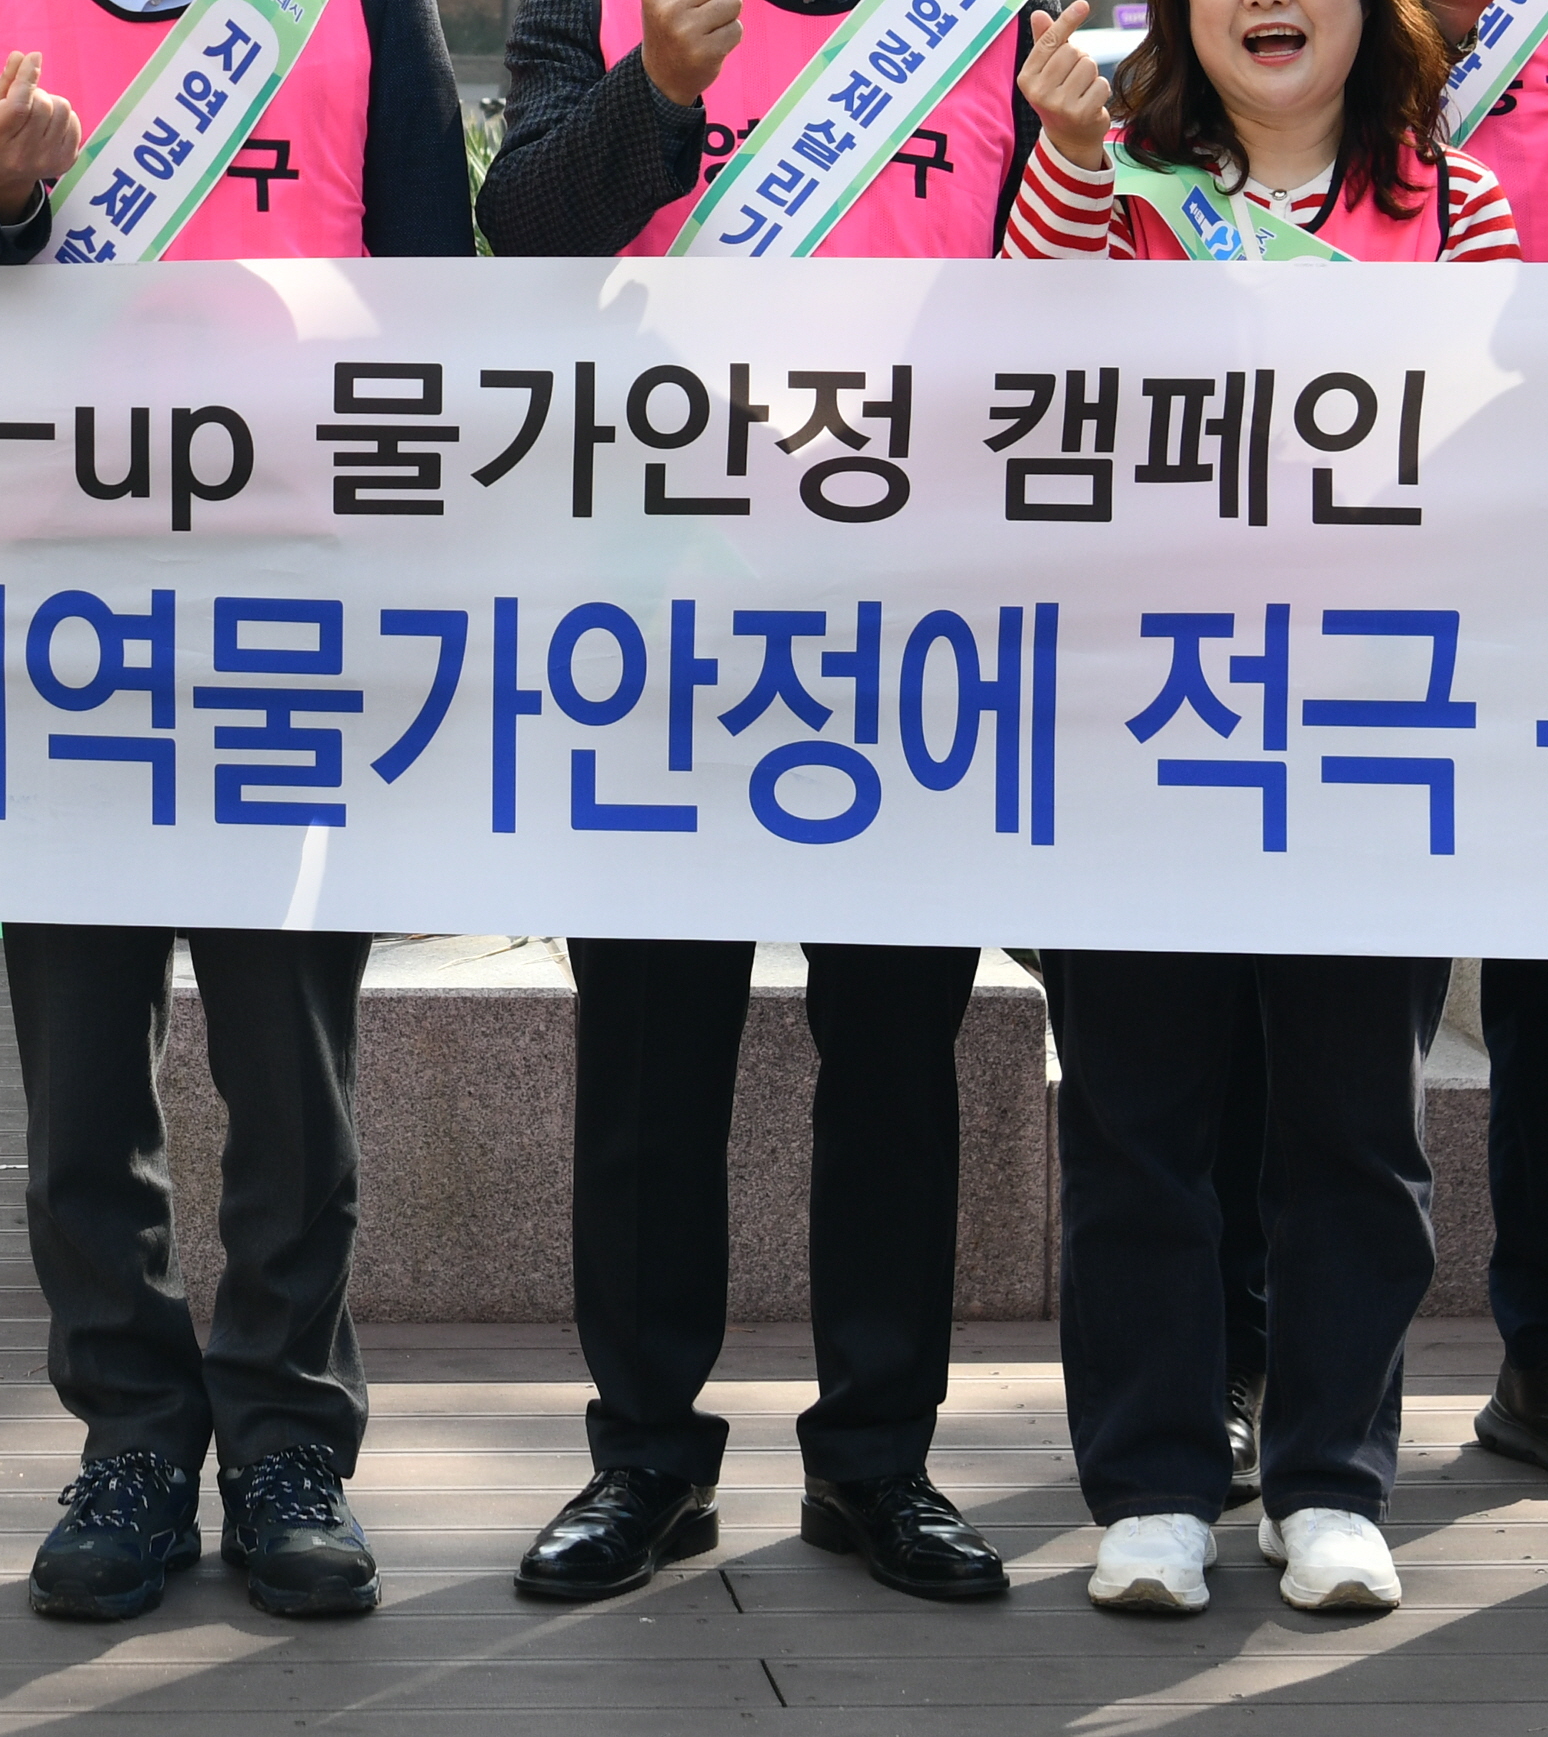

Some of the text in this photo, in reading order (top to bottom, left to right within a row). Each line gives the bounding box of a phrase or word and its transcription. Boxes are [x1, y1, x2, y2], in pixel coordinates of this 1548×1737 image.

[315, 361, 912, 524] 물가안정
[982, 367, 1426, 527] 캠페인
[1125, 603, 1477, 856] 적극
